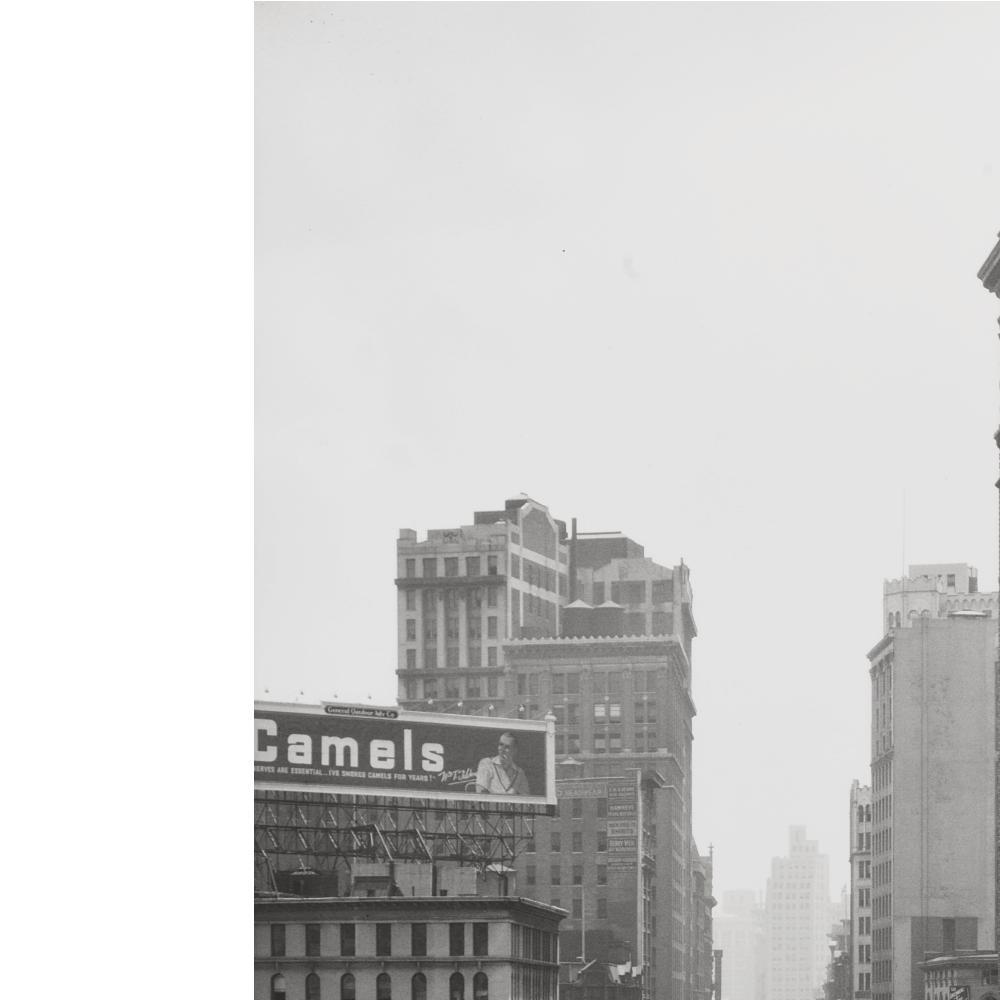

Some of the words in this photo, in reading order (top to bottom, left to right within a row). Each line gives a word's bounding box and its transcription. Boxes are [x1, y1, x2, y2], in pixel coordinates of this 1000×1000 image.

[254, 718, 444, 772] Camels
[341, 770, 366, 778] SMOKED
[368, 772, 392, 780] CAMELS
